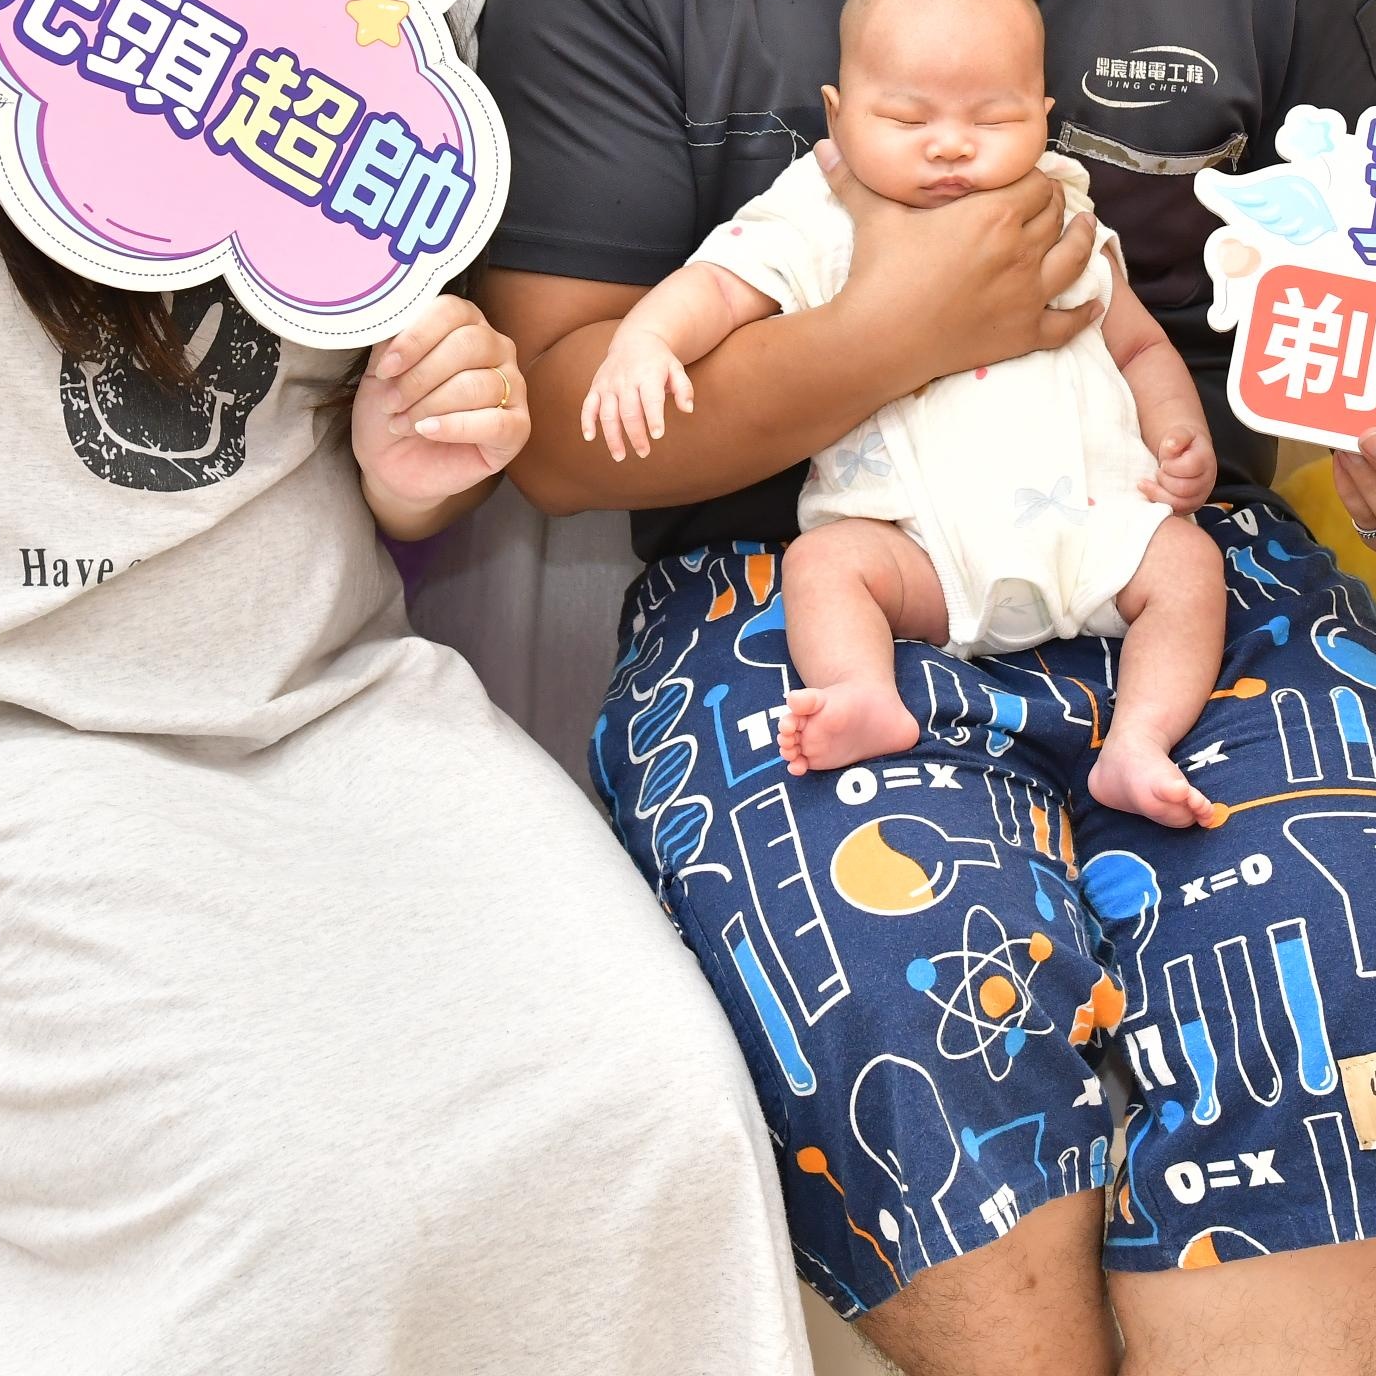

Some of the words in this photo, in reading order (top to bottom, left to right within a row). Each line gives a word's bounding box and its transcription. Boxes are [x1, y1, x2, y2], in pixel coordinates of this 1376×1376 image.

[1107, 80, 1141, 90] DING
[1149, 83, 1188, 93] CHEN
[19, 548, 114, 587] Have
